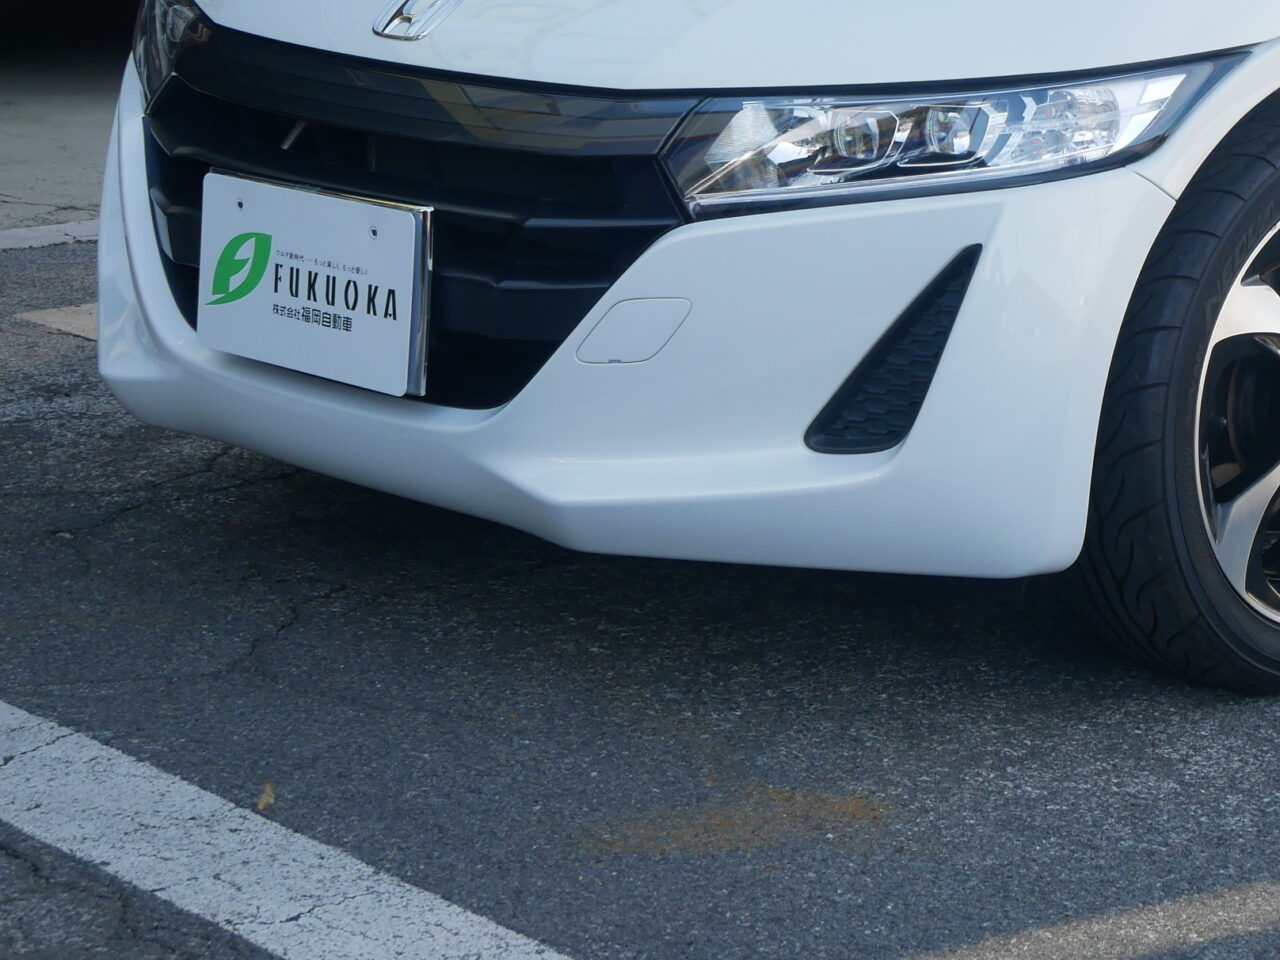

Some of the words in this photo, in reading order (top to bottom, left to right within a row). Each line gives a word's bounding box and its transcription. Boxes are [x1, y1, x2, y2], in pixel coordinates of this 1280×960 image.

[273, 263, 398, 321] FUKUOKA
[272, 303, 353, 333] 株式会社福岡自動車
